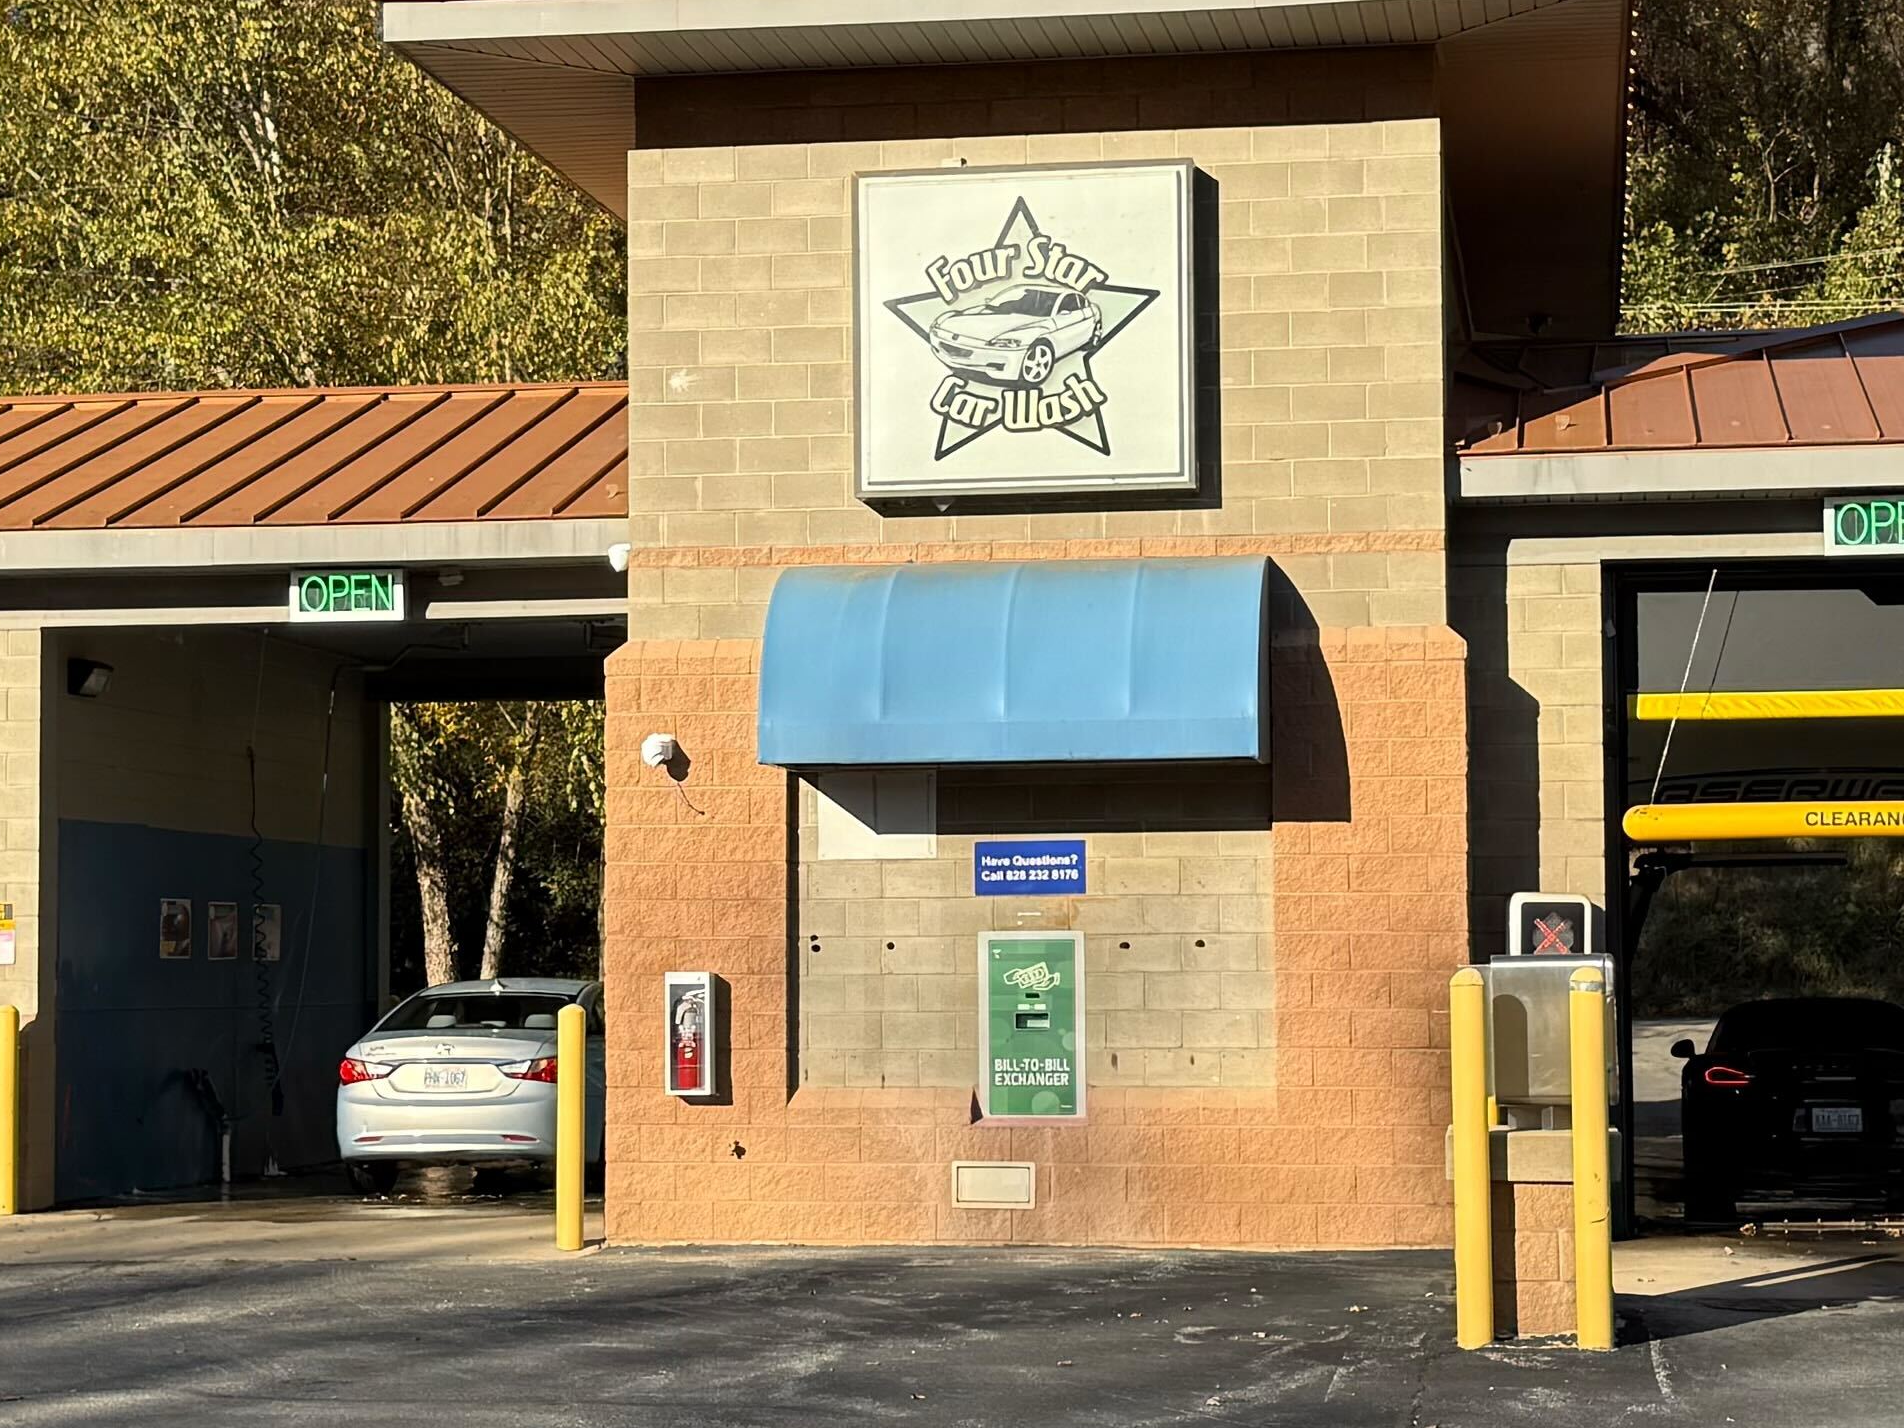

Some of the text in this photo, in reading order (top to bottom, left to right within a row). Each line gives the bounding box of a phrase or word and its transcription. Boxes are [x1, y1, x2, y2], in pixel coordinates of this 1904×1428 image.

[926, 235, 1109, 304] Four Star
[931, 374, 1108, 431] Car Wash
[301, 573, 393, 612] OPEN
[981, 853, 1078, 866] Have Questions?
[981, 871, 1004, 881] Call
[1006, 870, 1026, 881] 828
[1028, 869, 1049, 880] 232
[994, 1058, 1070, 1072] BILL-TO-BILL
[994, 1072, 1070, 1086] EXCHANGER
